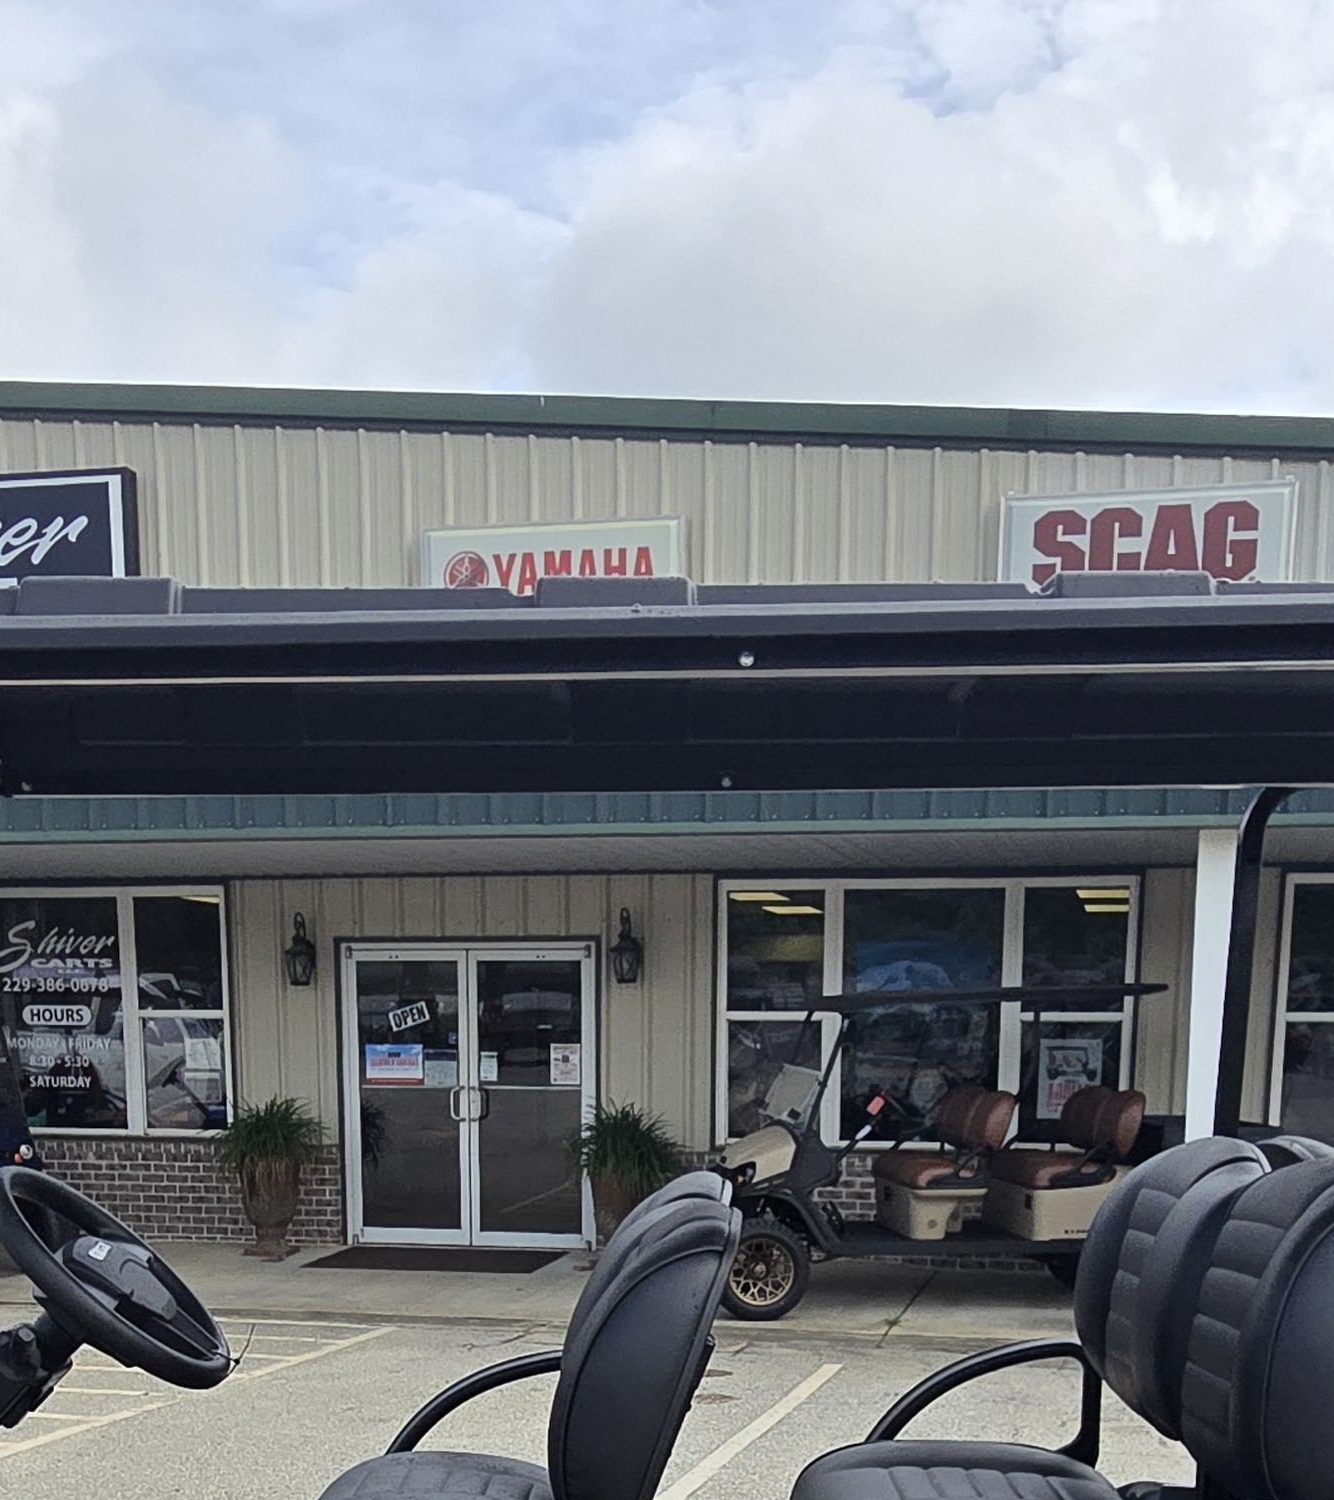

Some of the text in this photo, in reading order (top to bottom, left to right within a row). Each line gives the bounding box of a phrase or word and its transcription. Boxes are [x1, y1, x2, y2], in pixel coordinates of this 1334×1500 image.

[1032, 500, 1260, 582] SCAG
[492, 546, 654, 595] YAMAHA
[30, 958, 114, 969] CARTS
[29, 1008, 84, 1023] HOURS
[392, 1004, 427, 1029] OPEN
[8, 1037, 59, 1050] MONDAY
[68, 1037, 111, 1050] FRIDAY
[64, 1055, 90, 1068] 5:30
[29, 1075, 92, 1088] SATURDAY
